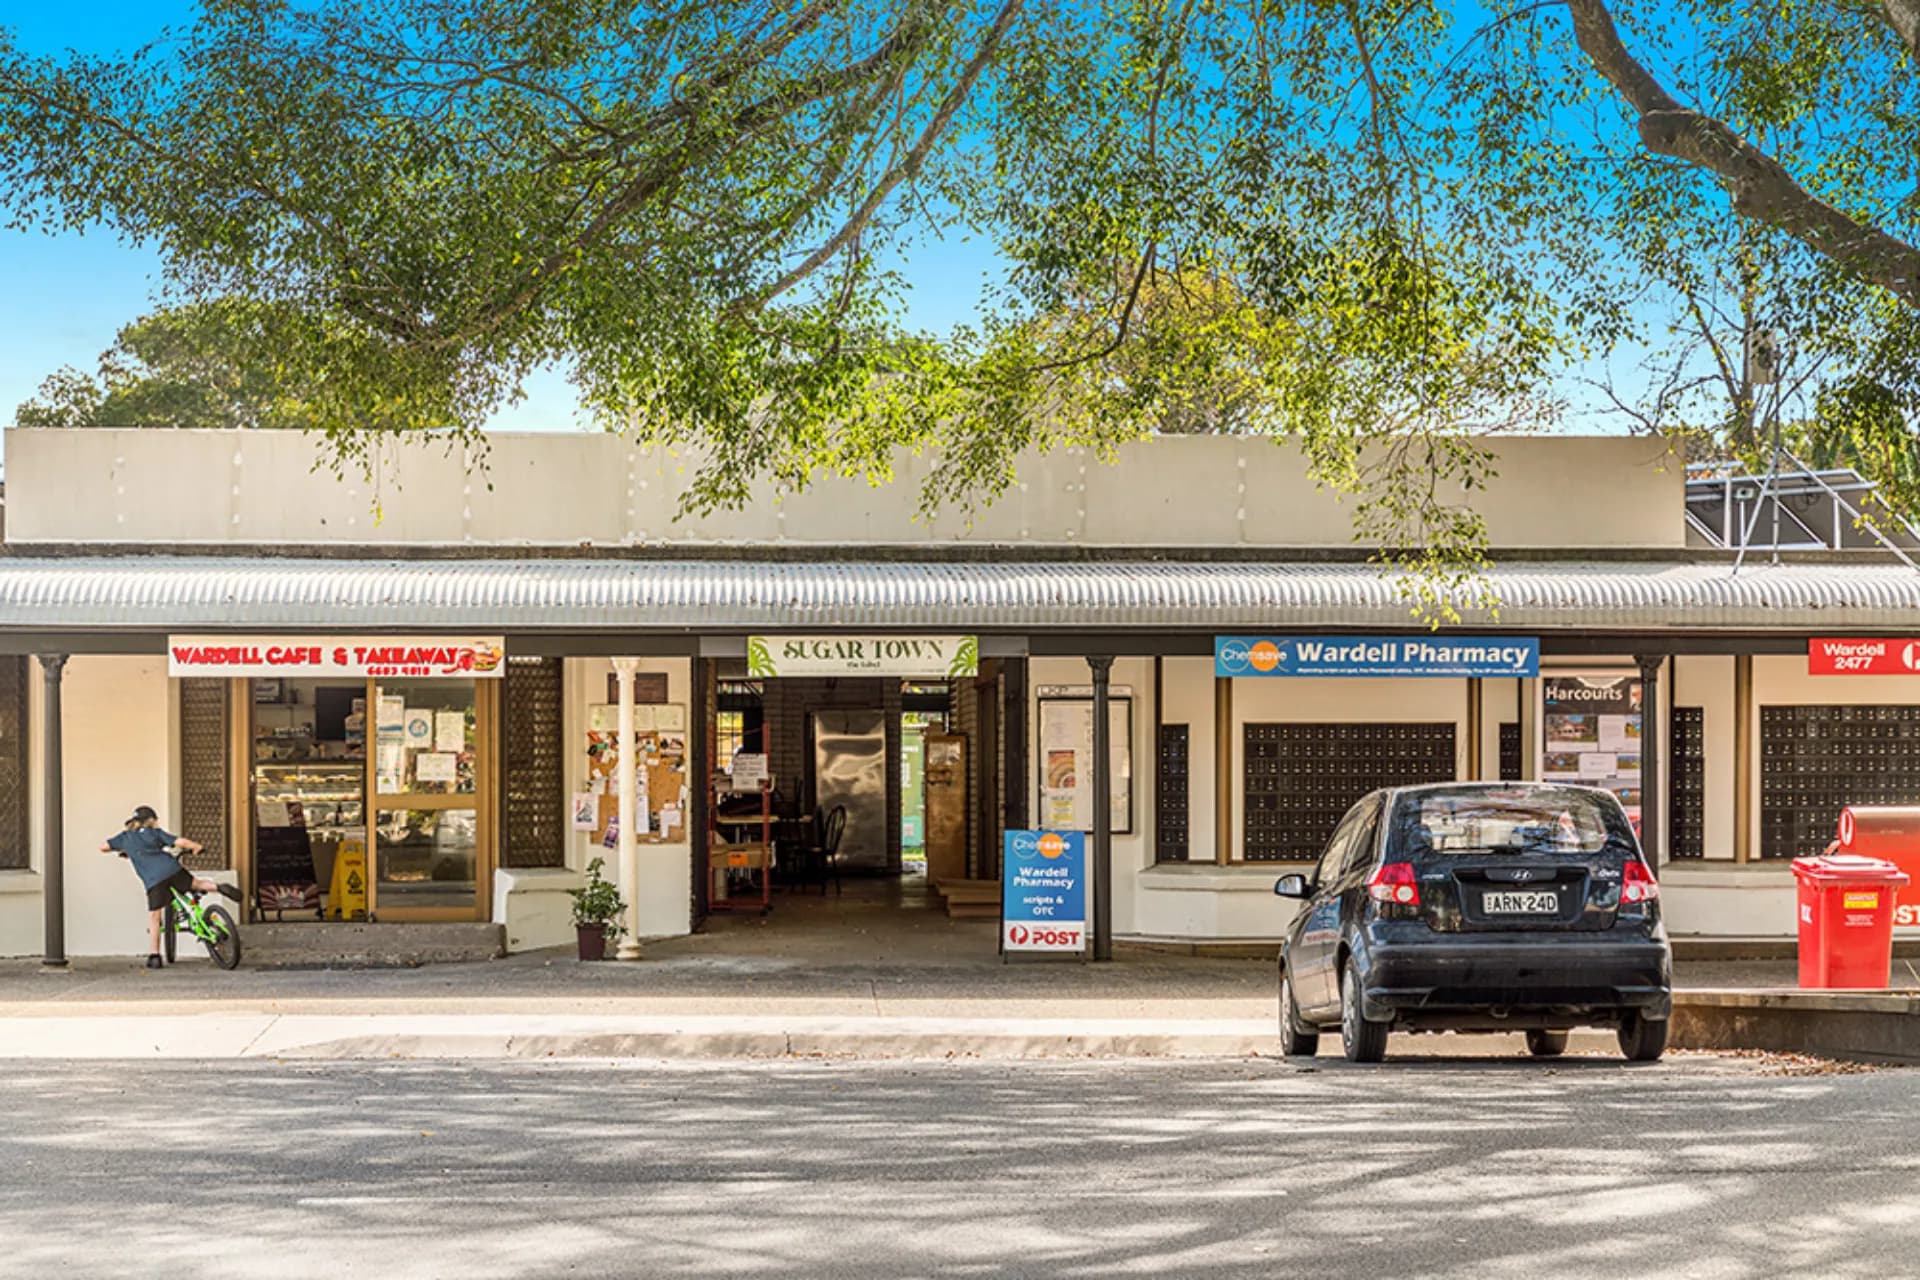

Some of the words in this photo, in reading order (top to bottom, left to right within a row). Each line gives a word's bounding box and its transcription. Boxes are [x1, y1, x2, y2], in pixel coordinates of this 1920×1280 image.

[172, 646, 264, 665] WARDELL
[266, 646, 322, 665] CAFE
[354, 646, 459, 665] TAKEAWAY
[783, 639, 864, 660] SUGAR
[869, 639, 944, 660] TOWN
[1296, 642, 1397, 662] Wardell
[1403, 642, 1530, 668] Pharmacy
[1823, 643, 1885, 656] Wardell
[1834, 656, 1873, 669] 2477
[1545, 686, 1623, 700] Harcourts
[1019, 867, 1069, 877] Wardell
[1013, 877, 1074, 890] Pharmacy
[1033, 907, 1054, 916] OTC
[1032, 931, 1080, 945] POST
